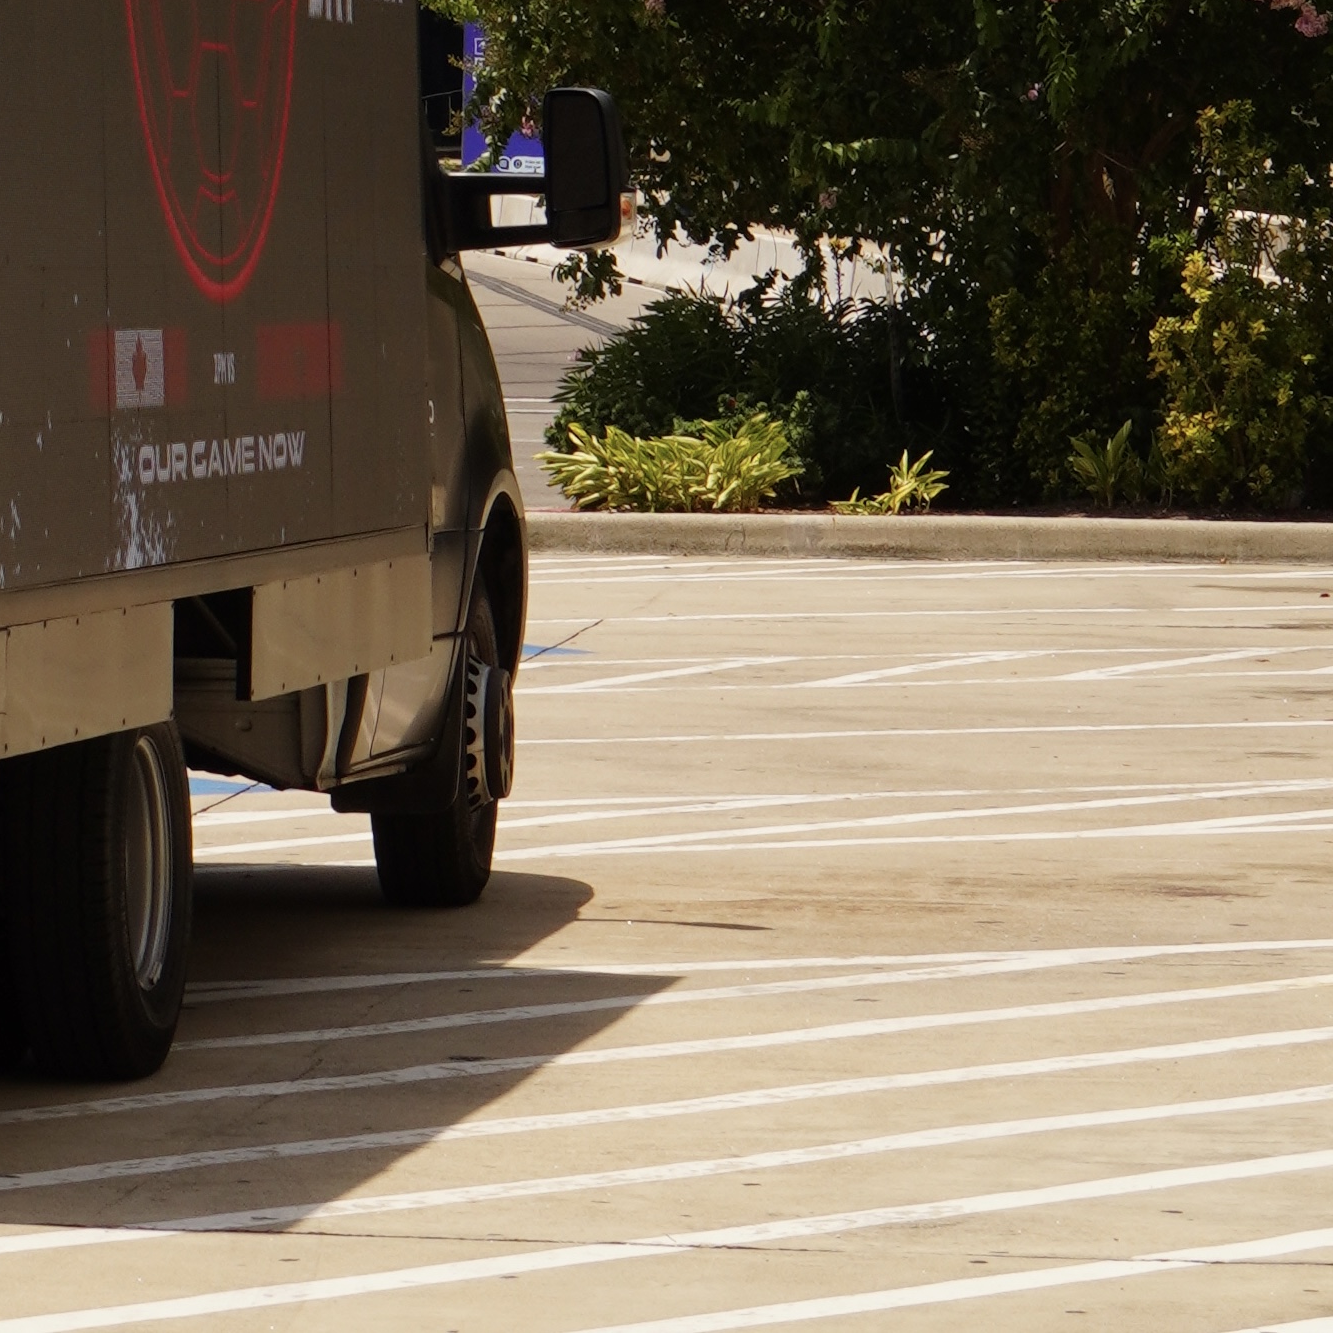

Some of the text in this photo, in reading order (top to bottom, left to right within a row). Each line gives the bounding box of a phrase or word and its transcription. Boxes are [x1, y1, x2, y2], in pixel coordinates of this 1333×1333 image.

[138, 430, 305, 484] OUR GAME NOW
